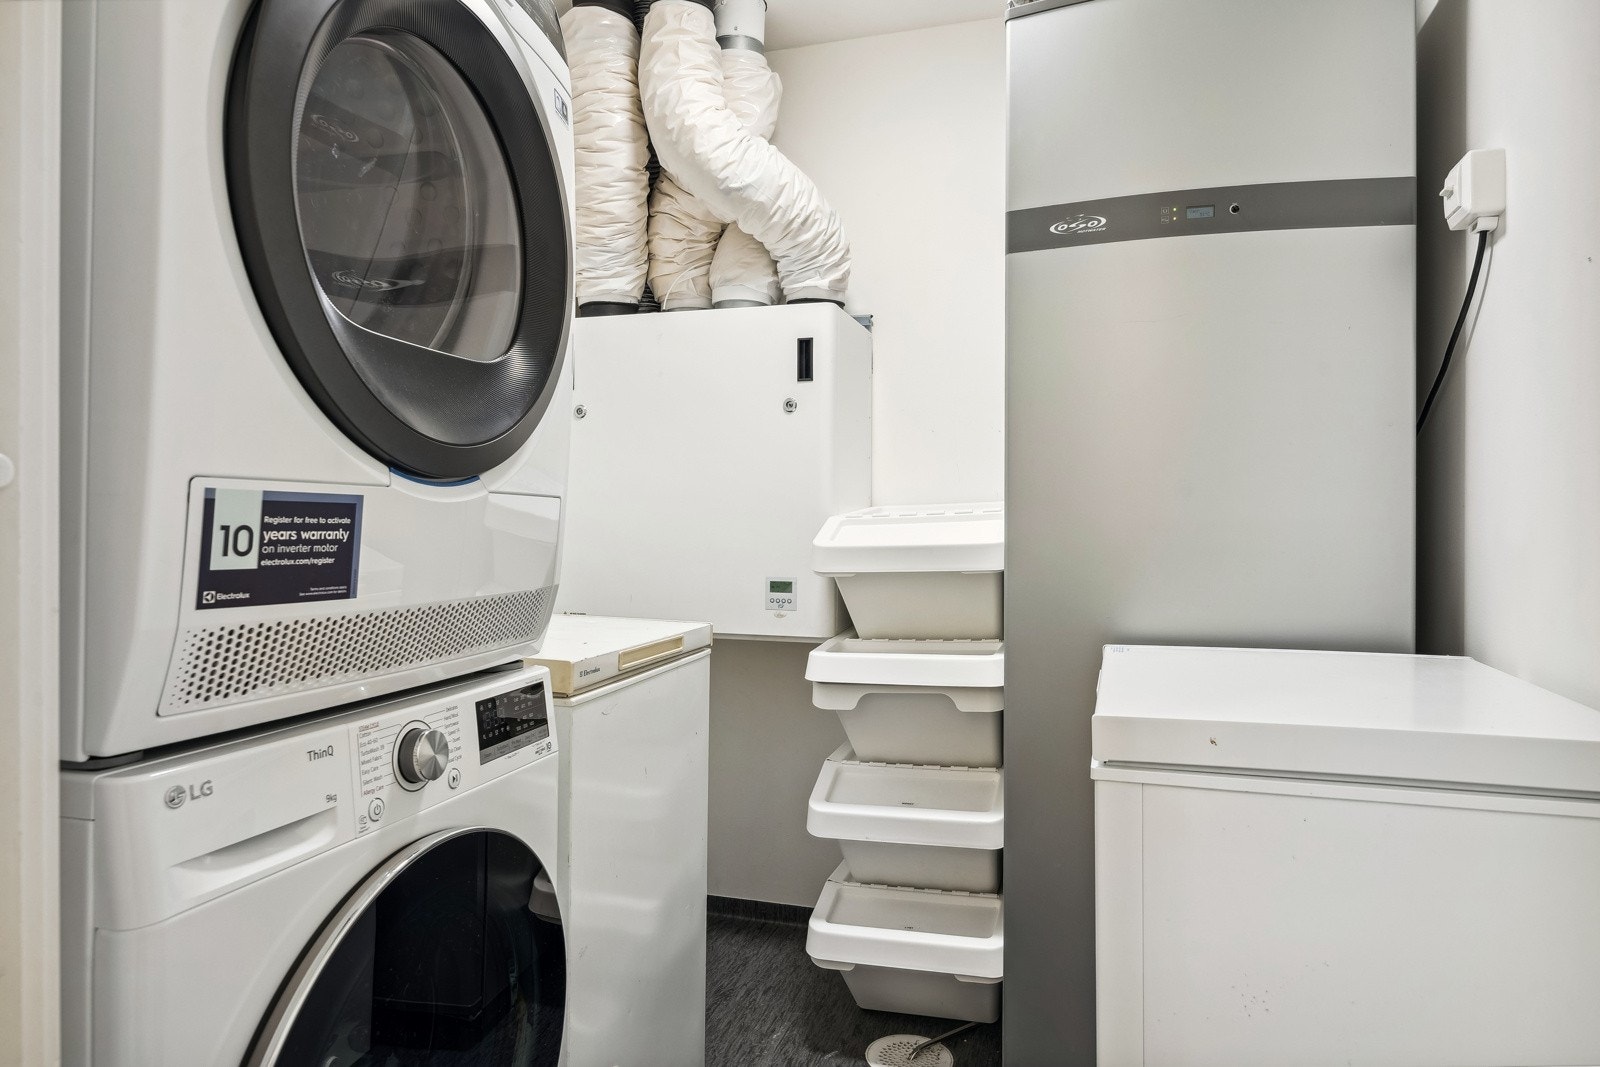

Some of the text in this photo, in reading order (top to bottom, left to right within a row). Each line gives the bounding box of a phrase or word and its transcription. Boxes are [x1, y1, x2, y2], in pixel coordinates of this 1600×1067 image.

[264, 516, 292, 525] Register
[294, 516, 304, 524] for
[304, 516, 318, 524] free
[327, 516, 351, 524] activate
[220, 524, 254, 557] 10
[263, 528, 350, 543] years warranty
[262, 544, 338, 554] on inverter motor
[260, 557, 335, 567] electrolux.com/register
[216, 592, 250, 602] Electrolux
[306, 745, 334, 762] ThinQ
[189, 780, 214, 802] LG
[326, 794, 338, 804] 9kg
